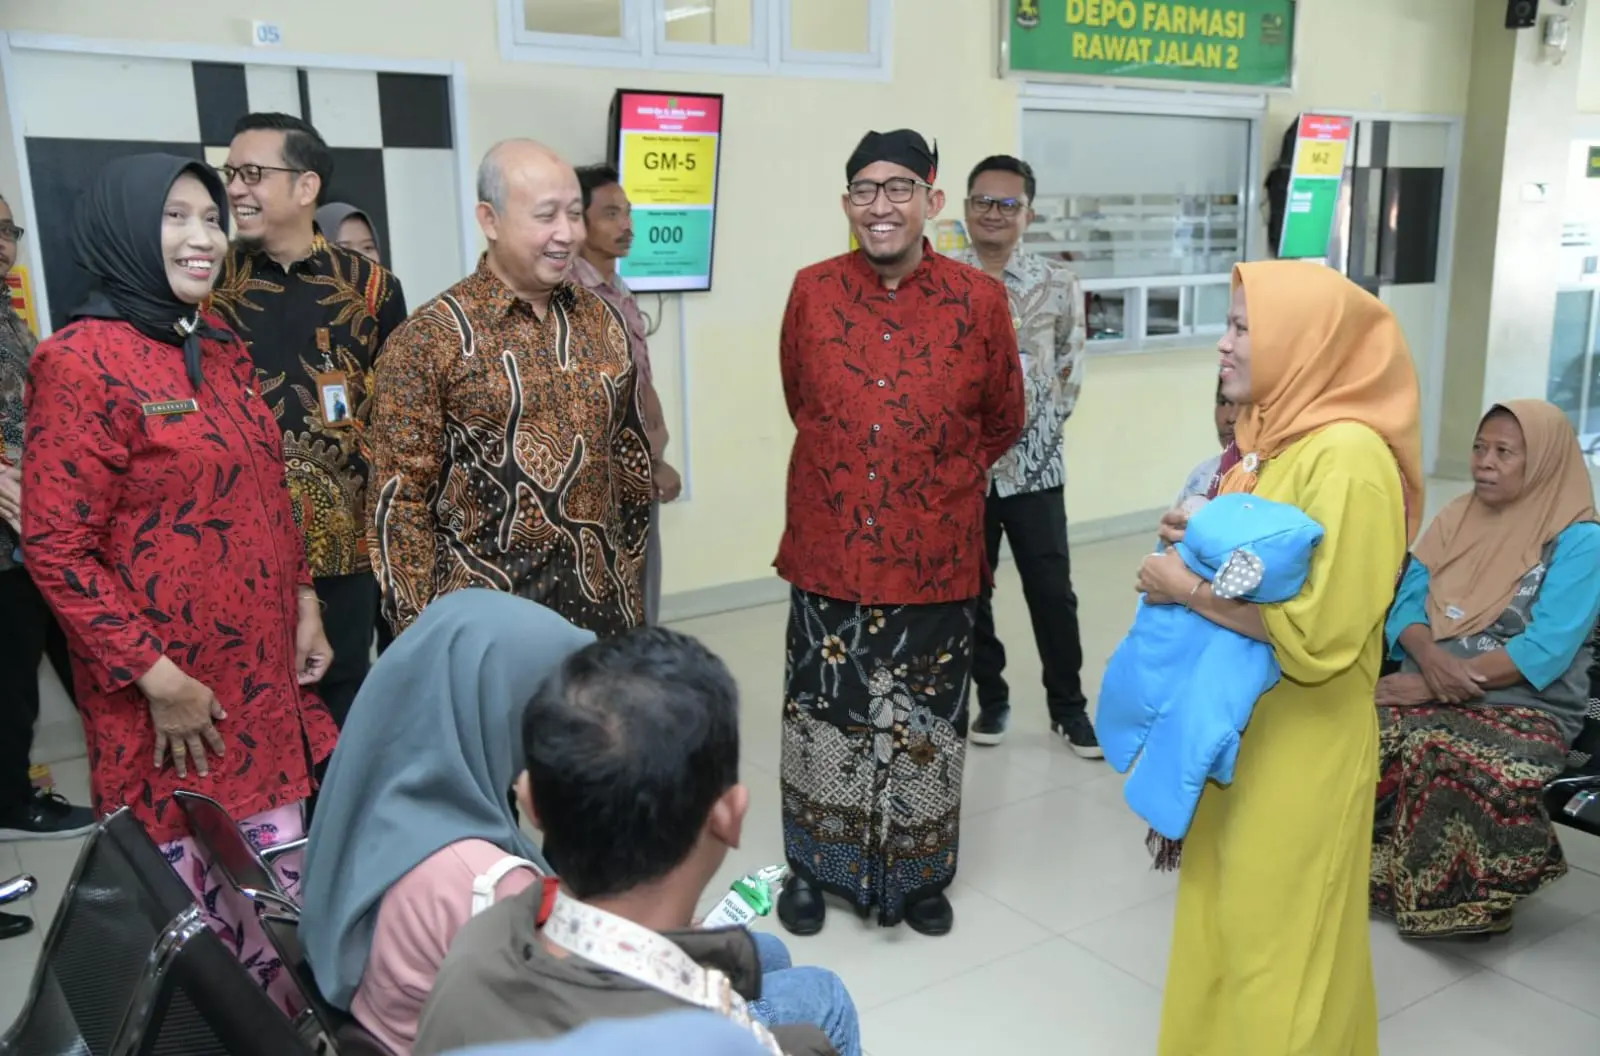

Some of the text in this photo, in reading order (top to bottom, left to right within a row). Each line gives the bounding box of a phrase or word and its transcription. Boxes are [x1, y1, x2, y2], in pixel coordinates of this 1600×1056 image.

[1066, 0, 1136, 29] DEPO
[1142, 3, 1245, 39] FARMASI
[257, 25, 280, 44] 05
[1072, 32, 1239, 70] RAWAT JALAN 2
[643, 151, 696, 171] GM-5
[649, 225, 683, 244] 000
